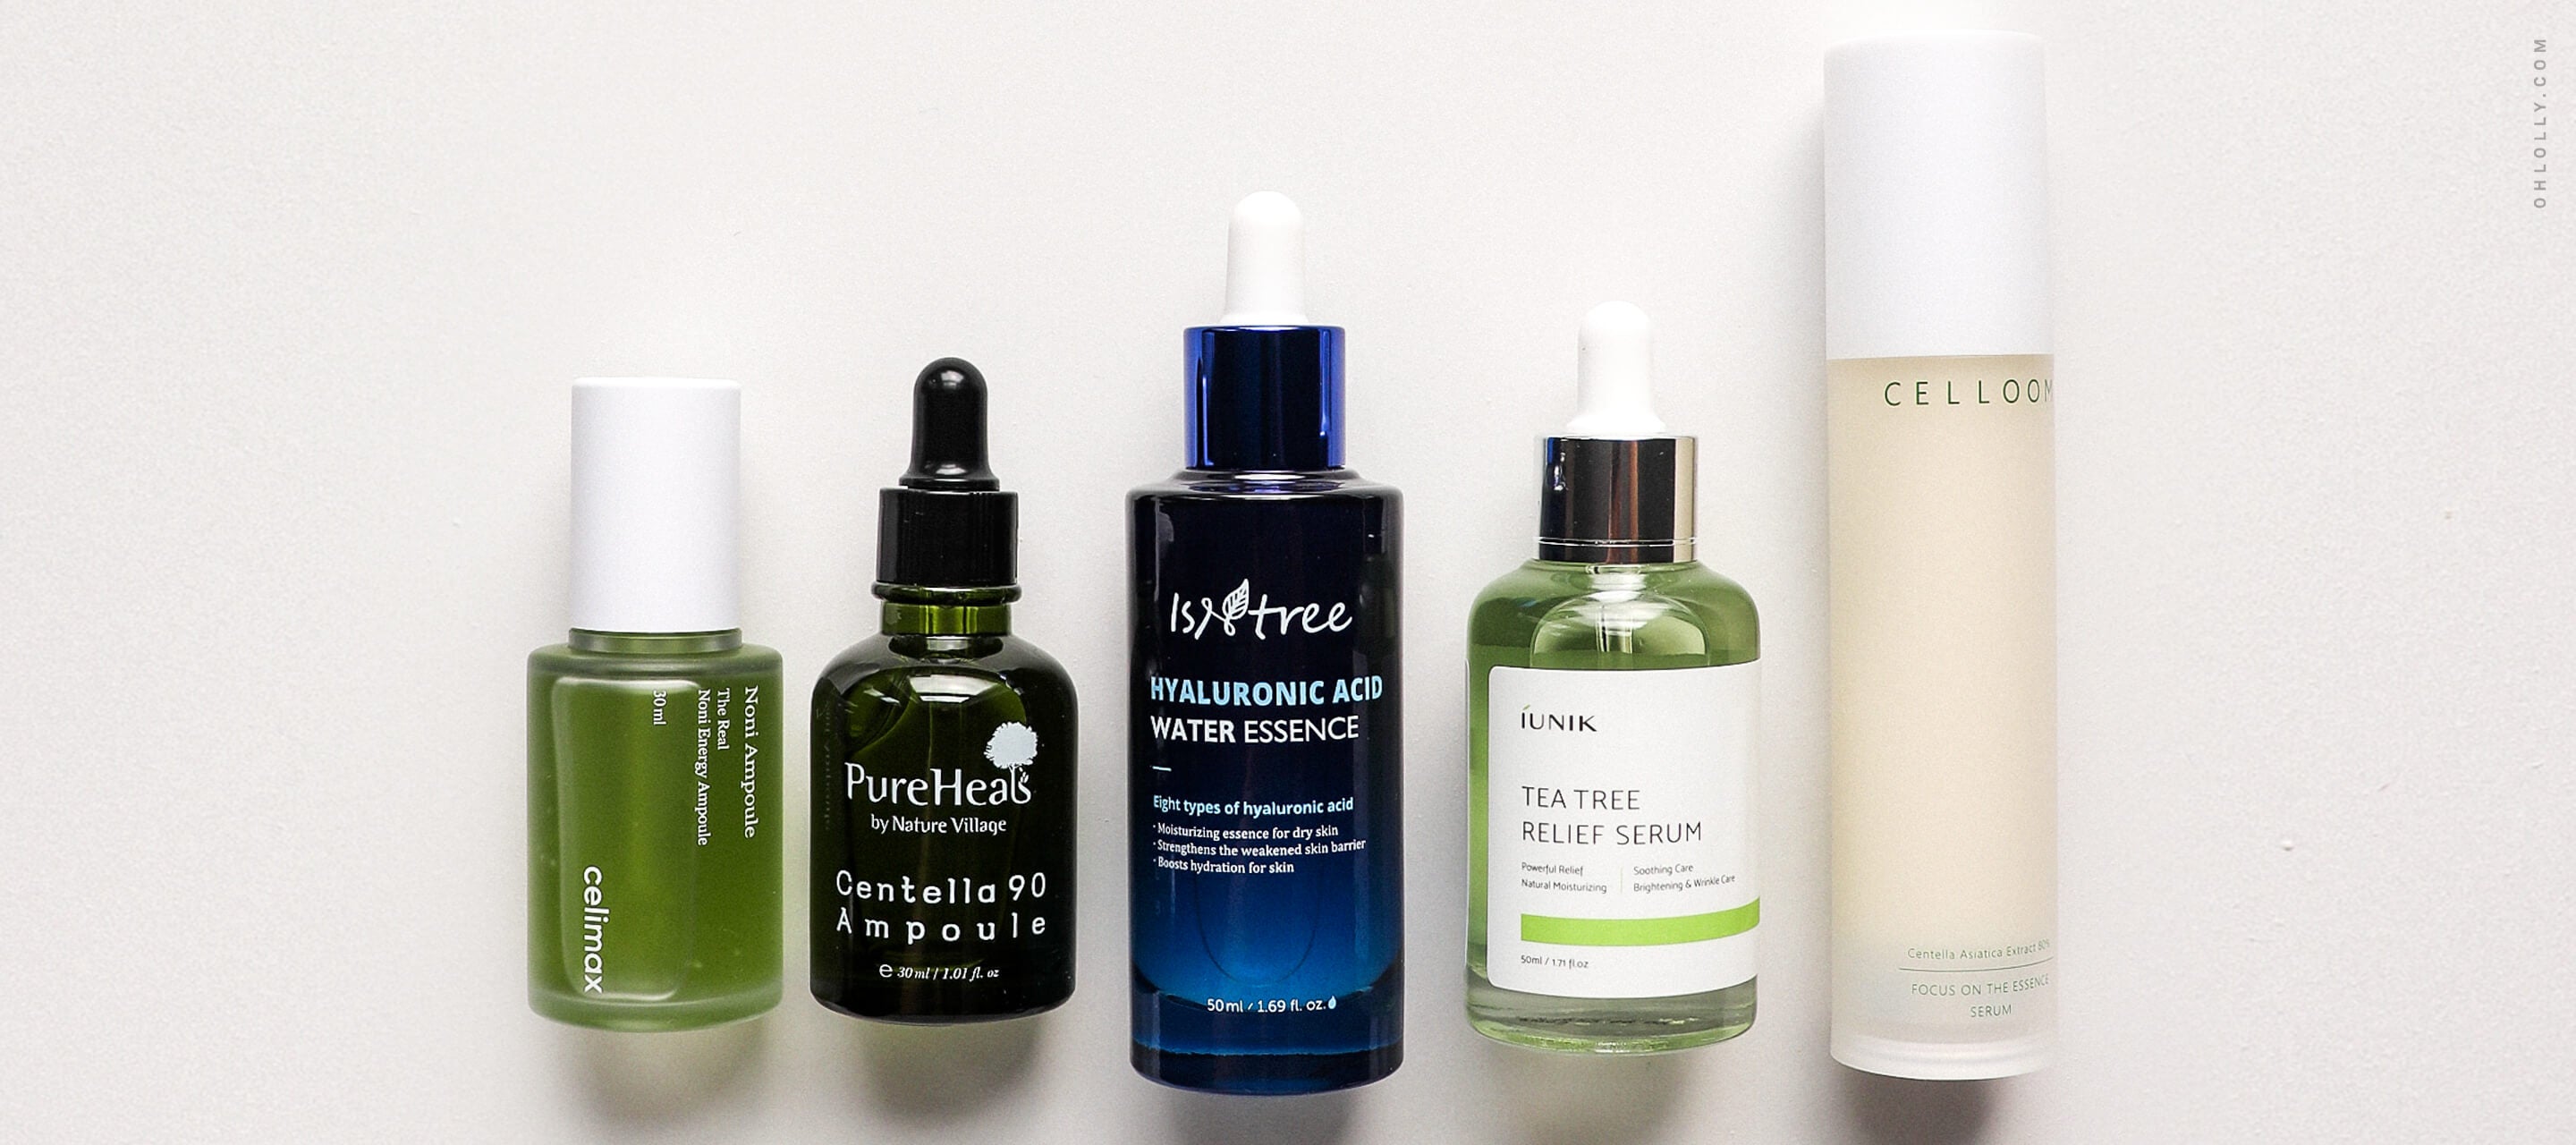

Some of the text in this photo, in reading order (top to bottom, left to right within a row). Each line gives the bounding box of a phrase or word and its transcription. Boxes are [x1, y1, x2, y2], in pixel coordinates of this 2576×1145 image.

[1884, 378, 2054, 407] CELLOOM
[1150, 675, 1383, 707] HYALURONIC ACID
[653, 690, 667, 725] 30ml
[716, 687, 731, 751] The Real
[1150, 716, 1360, 743] WATER ESSENCE
[694, 689, 712, 846] Noni Energy Ampoule
[741, 685, 759, 839] Noni Ampoule
[844, 761, 1032, 806] PureHeals
[1153, 794, 1354, 819] Eight types of hyaluronic acid
[1521, 786, 1641, 810] TEA TREE
[870, 813, 1007, 836] by Nature Village
[1157, 822, 1339, 842] Moisturizing essence for dry skin
[1521, 821, 1702, 845] RELIEF SERUM
[1157, 838, 1367, 857] Strengthens the weakened skin barrier
[1157, 856, 1295, 875] Boosts hydration for skin
[1521, 861, 1584, 877] Powerful Relief
[1633, 863, 1694, 877] Soothing Care
[835, 869, 1046, 904] Centella 90
[1521, 878, 1607, 895] Natural Moisturizing
[1633, 874, 1736, 895] Brightening & Wrinkle Care
[583, 865, 610, 994] celimax
[835, 906, 1046, 946] Ampoule
[1521, 954, 1543, 965] 50ml
[1907, 947, 1956, 960] Centella
[1960, 948, 2004, 960] Asiatica
[2006, 945, 2037, 956] Extract
[896, 966, 931, 980] 30ml
[932, 966, 939, 981] /
[943, 967, 967, 980] 1.01
[969, 966, 984, 983] fl.
[987, 969, 1000, 978] oz
[1911, 972, 2049, 997] FOCUS ON THE ESSENCE
[1207, 998, 1326, 1014] 50ml / 1.69 fl. oz.
[1970, 1004, 2012, 1018] SERUM
